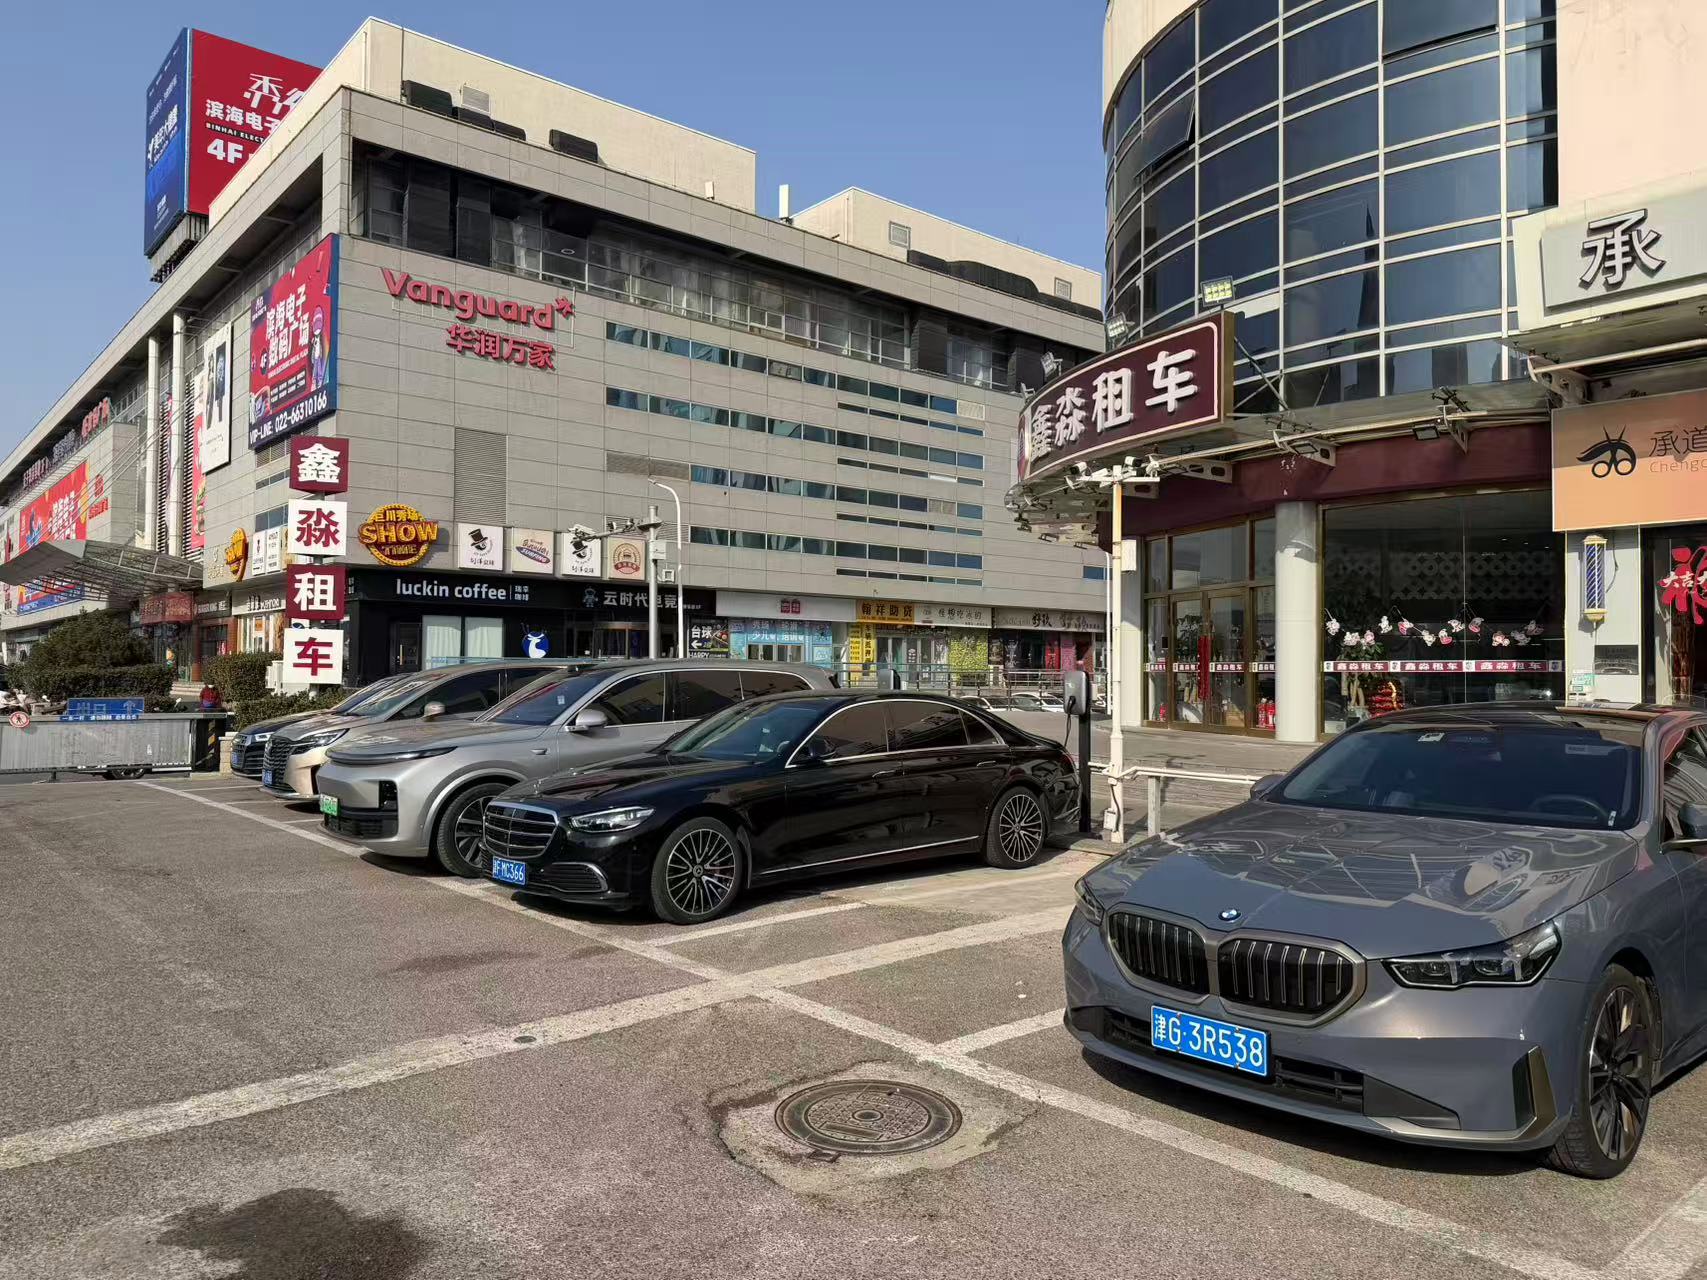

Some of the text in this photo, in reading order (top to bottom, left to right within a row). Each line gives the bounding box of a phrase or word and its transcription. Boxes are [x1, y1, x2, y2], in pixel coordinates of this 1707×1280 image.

[206, 122, 238, 137] BINHAI
[207, 138, 244, 164] 4F
[1579, 208, 1666, 290] 承
[381, 267, 554, 330] Vanguard
[265, 283, 307, 341] 滨海电子
[267, 312, 310, 367] 数码广场
[446, 323, 557, 370] 华润万家
[275, 391, 328, 434] 022-66310166
[1030, 348, 1199, 464] 鑫淼租车
[1649, 425, 1707, 457] 承道
[359, 521, 439, 544] SHOW
[292, 442, 342, 677] 鑫淼租车
[381, 544, 418, 555] TIME
[396, 578, 506, 601] luckin coffee
[691, 625, 712, 640] 台球
[1337, 662, 1384, 671] 鑫淼租车
[1405, 662, 1458, 671] 鑫淼租车
[1480, 661, 1543, 671] 鑫淼租车
[76, 702, 106, 716] 出口
